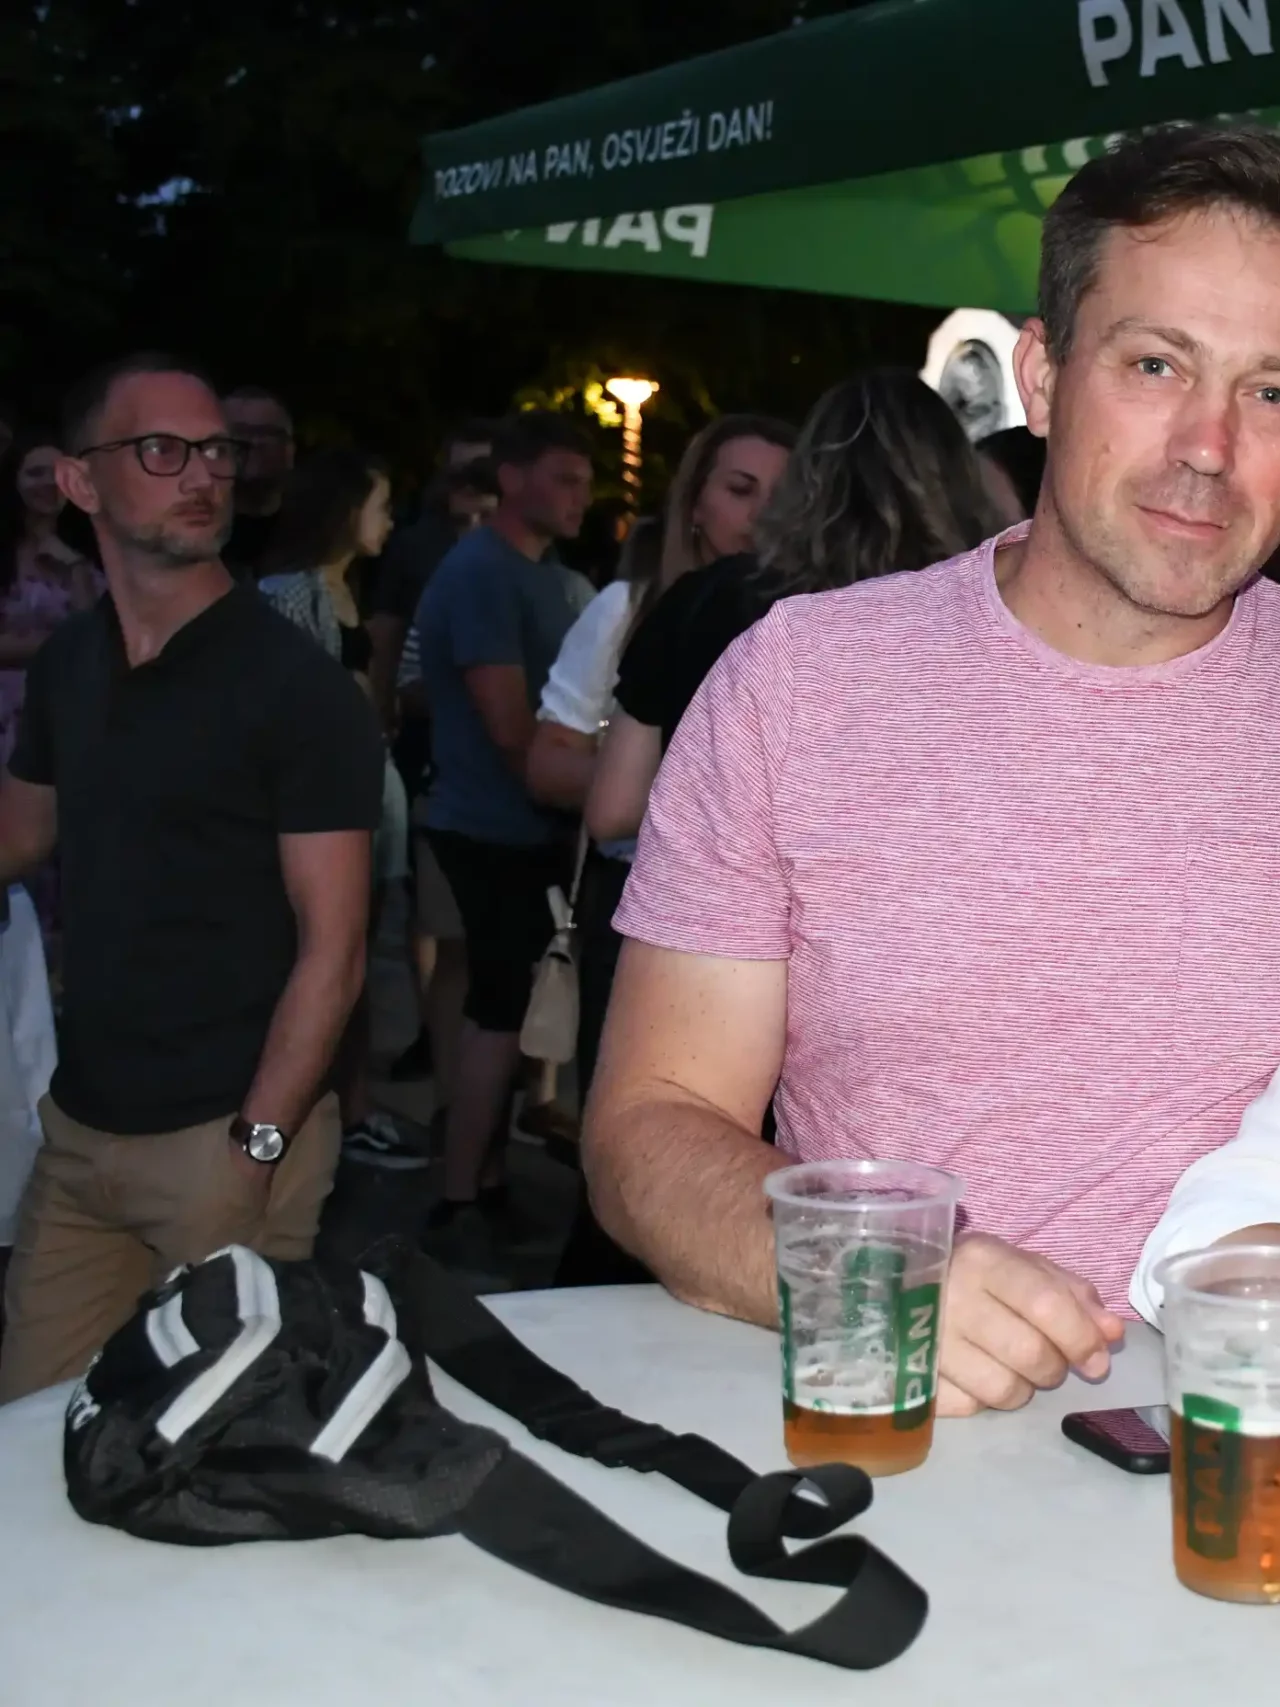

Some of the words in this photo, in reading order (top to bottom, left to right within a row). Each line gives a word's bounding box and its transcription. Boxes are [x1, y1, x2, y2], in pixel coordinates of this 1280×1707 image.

[1079, 0, 1274, 87] PAN
[505, 149, 538, 188] NA
[543, 138, 595, 180] PAN,
[601, 108, 701, 171] OSVJEŽI
[706, 100, 774, 152] DAN!
[904, 1304, 934, 1410] PAN
